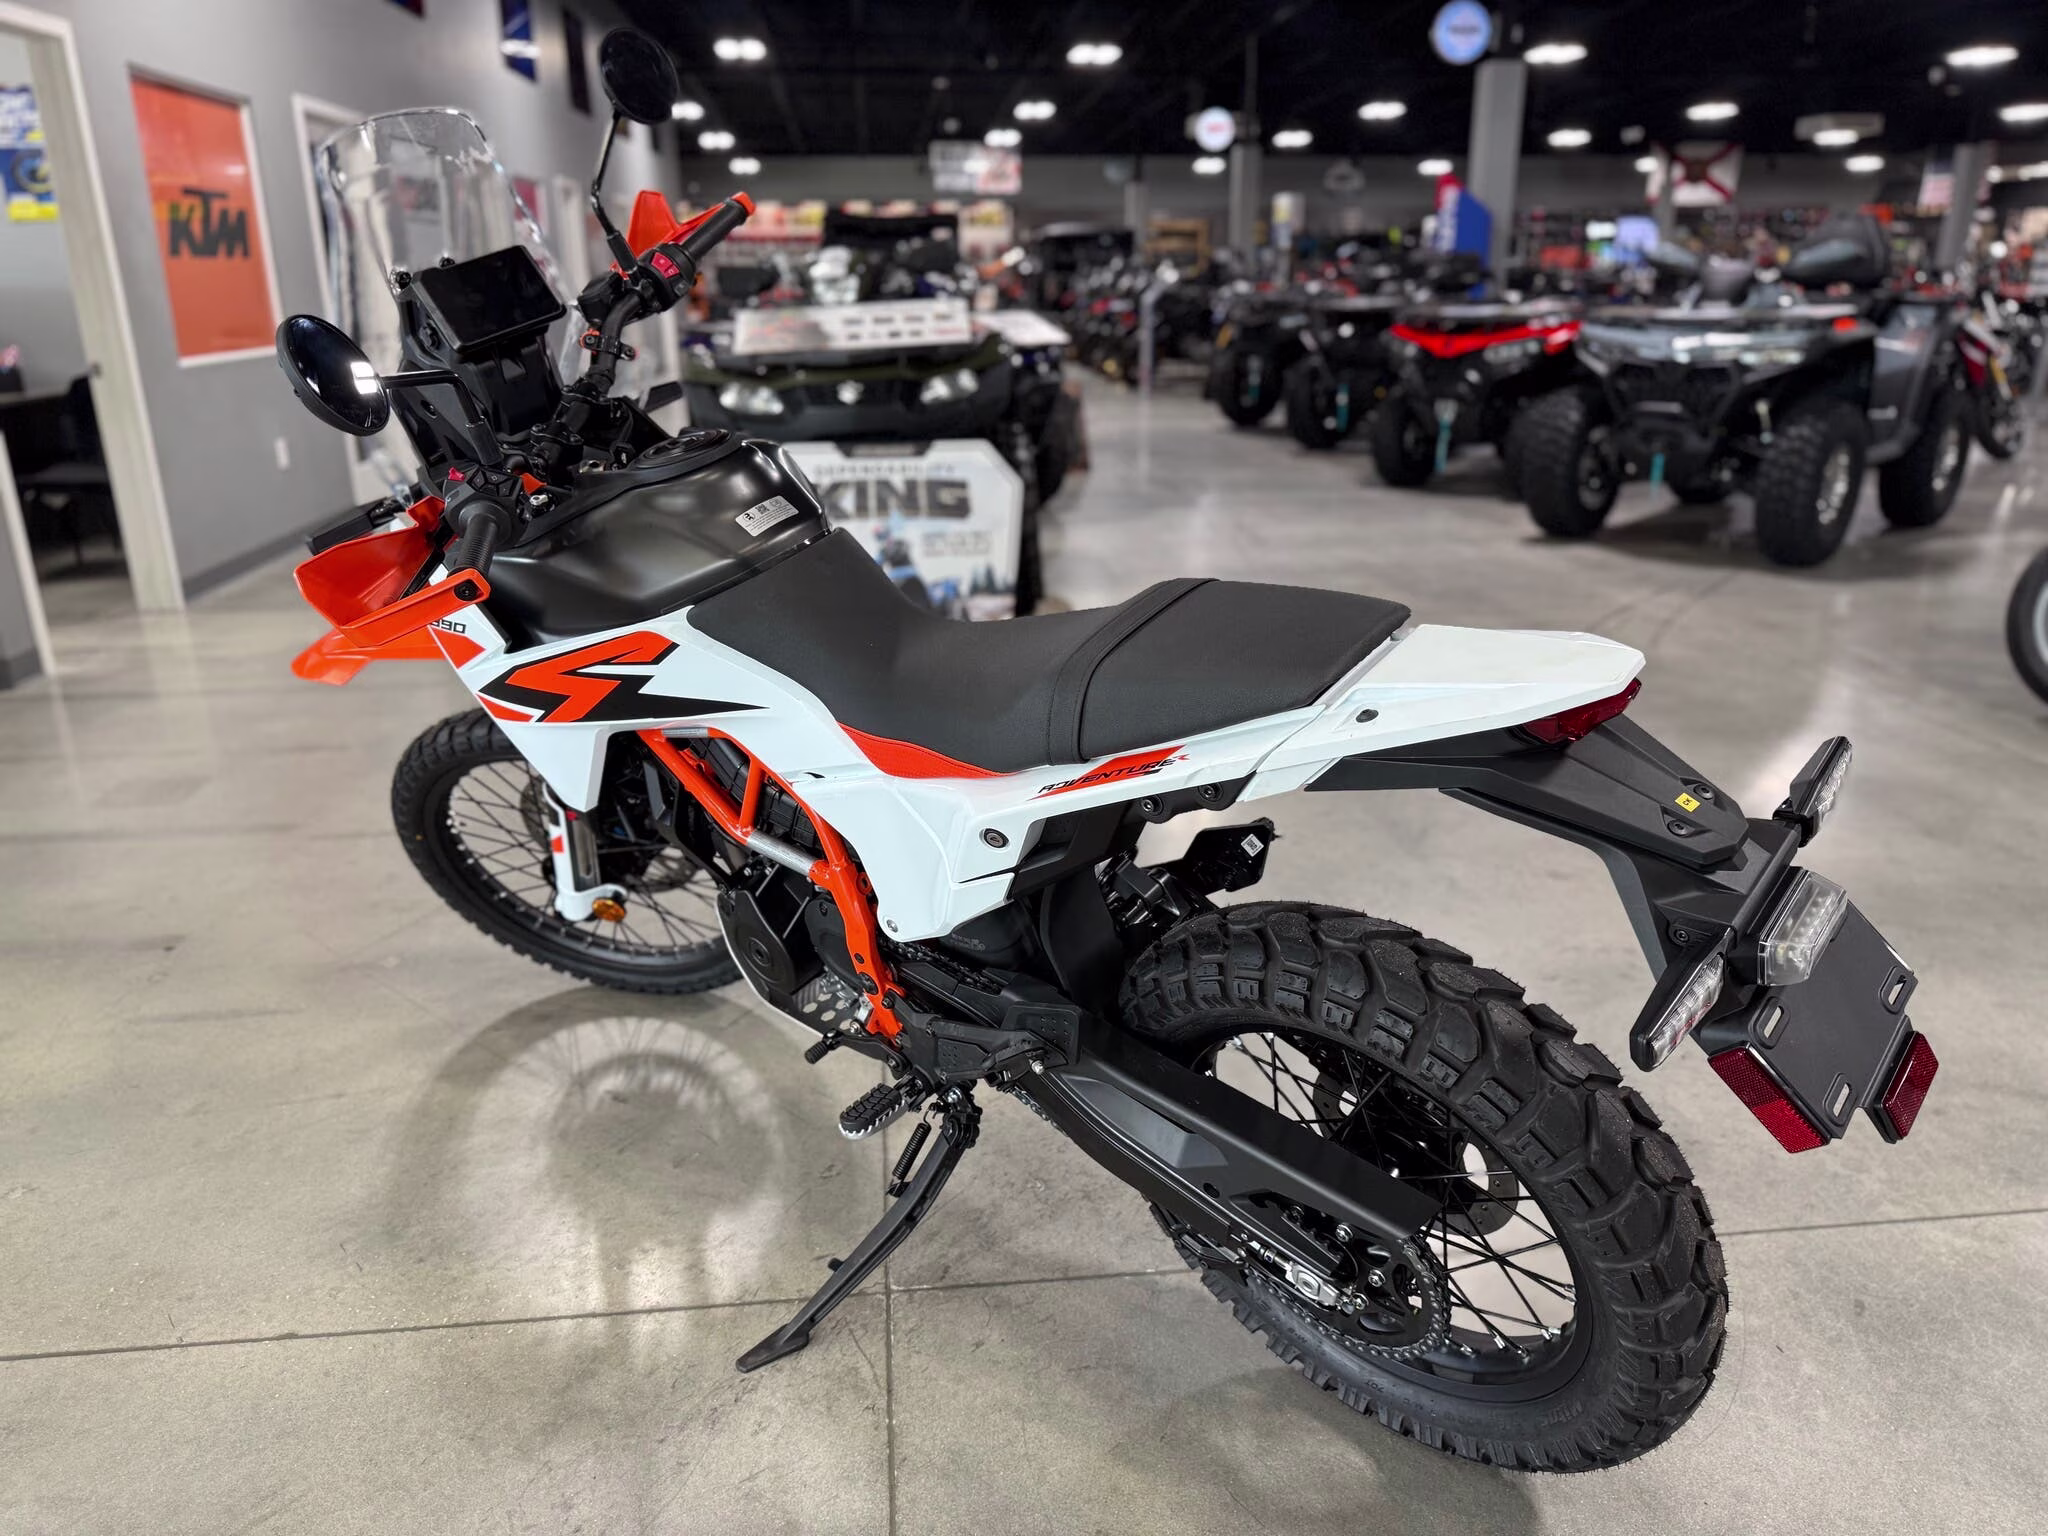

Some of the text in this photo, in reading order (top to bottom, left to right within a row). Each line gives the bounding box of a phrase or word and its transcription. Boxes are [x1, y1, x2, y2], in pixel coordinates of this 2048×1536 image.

[169, 187, 249, 258] KTM
[815, 480, 970, 518] KING
[1037, 757, 1177, 794] ADVENTURE
